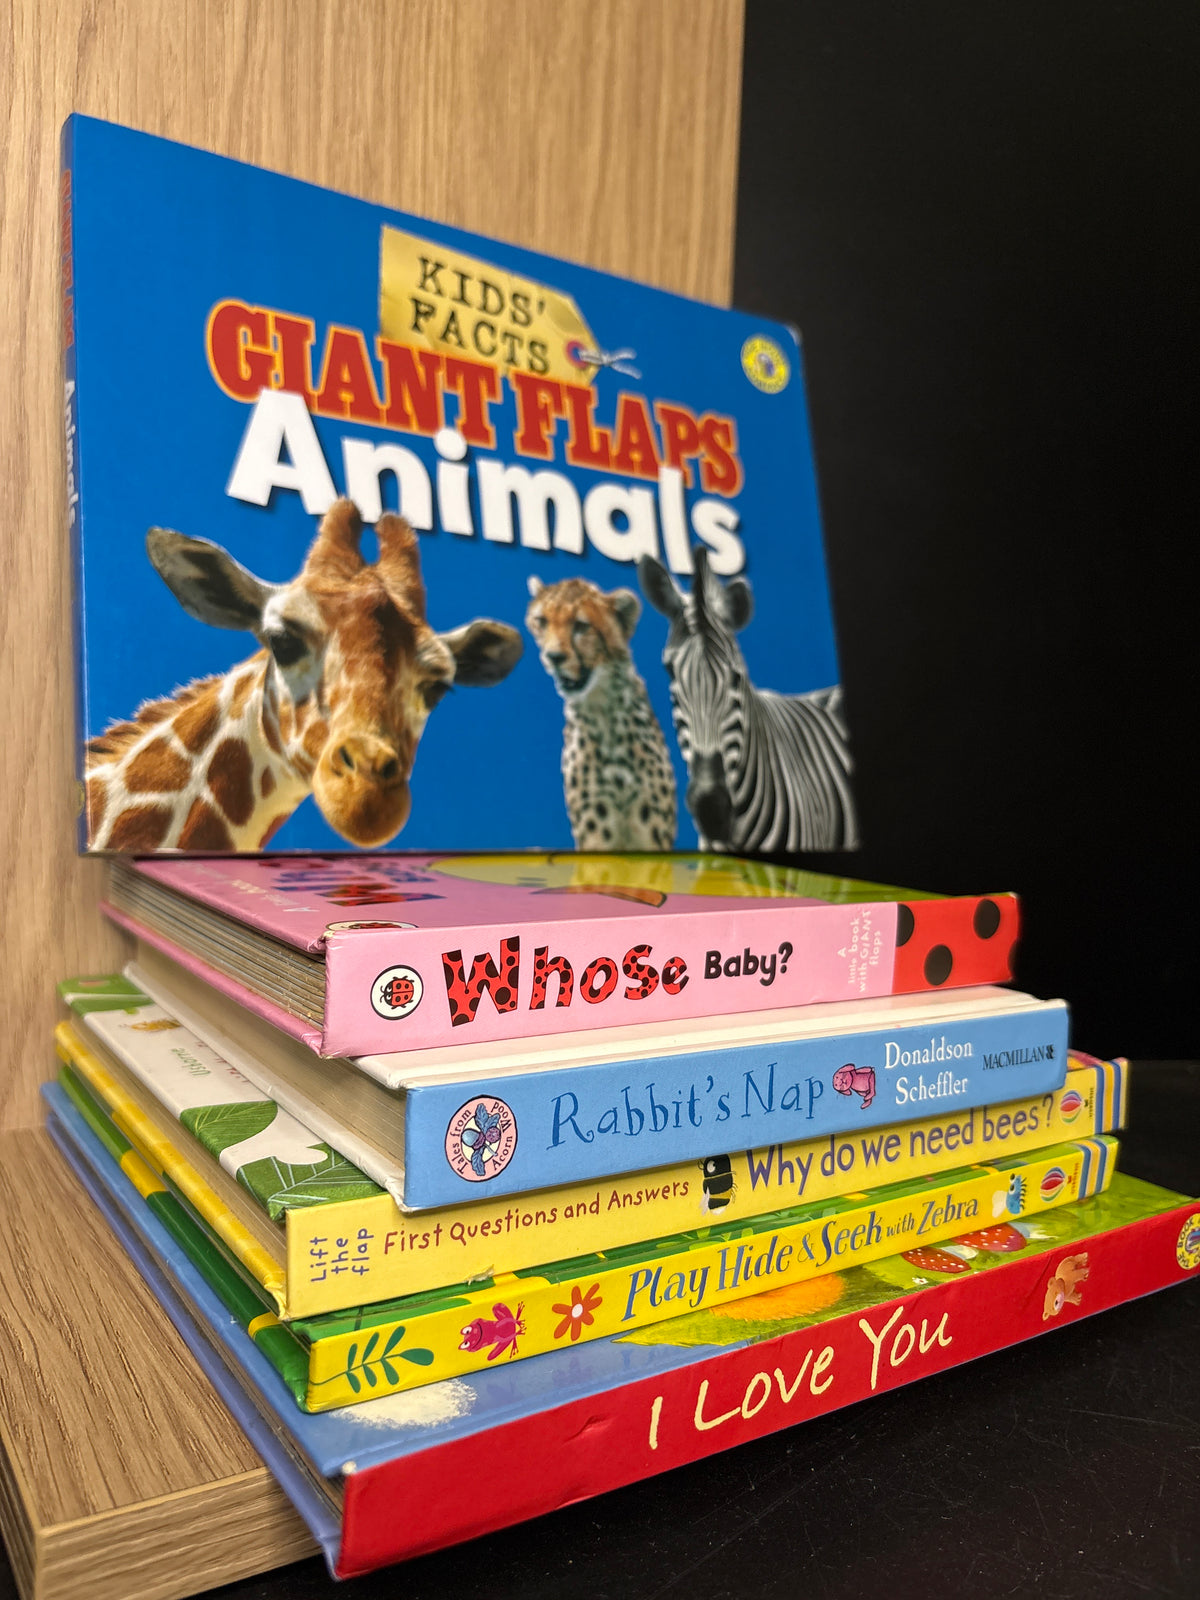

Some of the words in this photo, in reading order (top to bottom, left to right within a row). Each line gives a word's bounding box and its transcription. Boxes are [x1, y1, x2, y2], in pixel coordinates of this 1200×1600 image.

[416, 255, 545, 328] KIDS'
[410, 297, 550, 376] FACTS
[206, 298, 503, 450] GIANT
[509, 369, 744, 498] FLAPS
[226, 387, 747, 577] Animals
[836, 946, 847, 958] A
[847, 917, 860, 953] book
[860, 910, 872, 959] GIANT
[868, 930, 883, 966] flaps
[703, 941, 794, 987] Baby?
[857, 962, 867, 993] with
[884, 1036, 973, 1069] Donaldson
[982, 1044, 1045, 1070] MACMILLAN
[545, 1075, 732, 1151] Rabbit's
[740, 1061, 824, 1120] Nap
[895, 1078, 969, 1105] Scheffler
[450, 1109, 472, 1137] from
[490, 1101, 512, 1133] Wood
[451, 1141, 469, 1175] Tales
[491, 1135, 513, 1171] Acorn
[746, 1144, 814, 1196] Why
[820, 1134, 855, 1177] do
[861, 1134, 901, 1165] we
[908, 1108, 975, 1157] need
[383, 1224, 443, 1255] First
[449, 1208, 558, 1246] Questions
[563, 1193, 601, 1218] and
[606, 1178, 690, 1210] Answers
[309, 1236, 329, 1282] Lift
[331, 1237, 349, 1275] the
[351, 1228, 375, 1276] flap
[622, 1264, 711, 1322] Play
[718, 1235, 793, 1292] Hide
[797, 1235, 816, 1263] &
[815, 1211, 883, 1268] Seek
[886, 1214, 915, 1237] with
[916, 1194, 979, 1235] Zebra
[649, 1396, 664, 1450] I
[693, 1345, 835, 1431] Love
[858, 1305, 953, 1391] You
